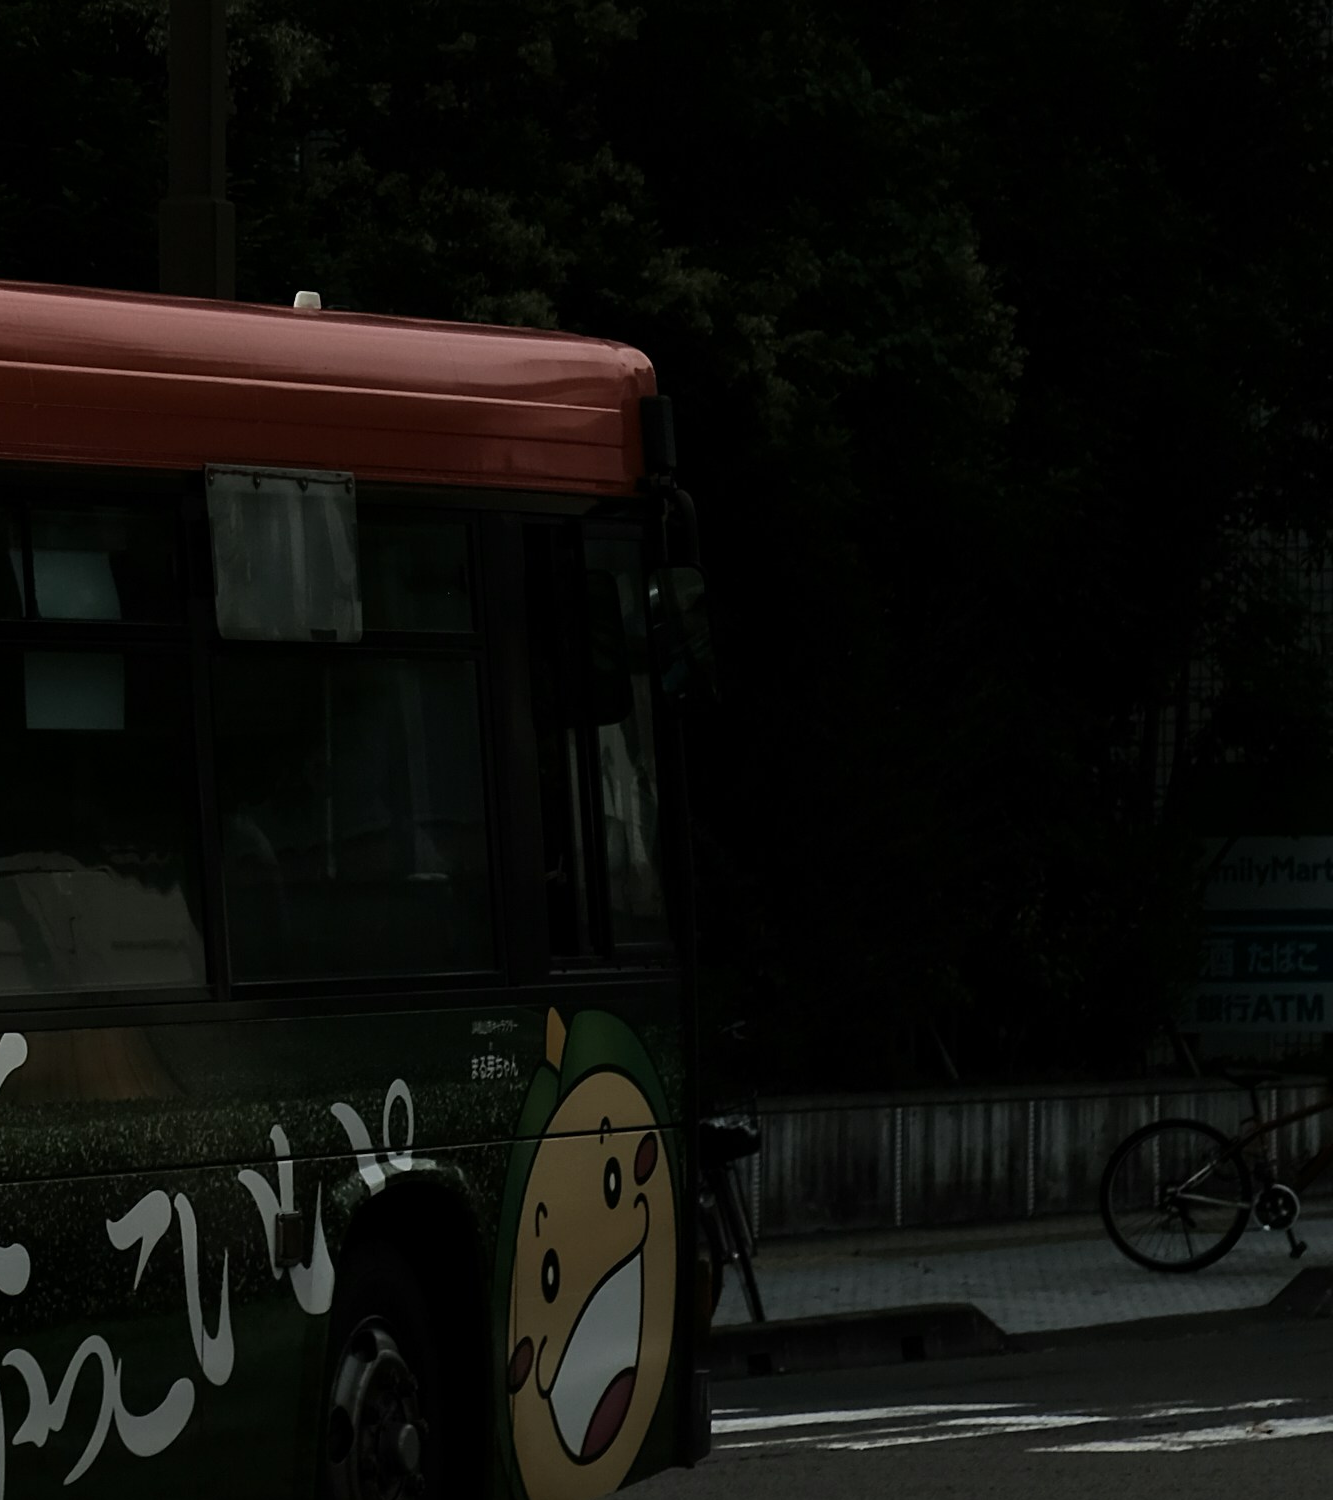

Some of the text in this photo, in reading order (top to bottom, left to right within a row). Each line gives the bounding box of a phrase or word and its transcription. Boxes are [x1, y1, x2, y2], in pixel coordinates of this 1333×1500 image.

[1247, 940, 1319, 975] たばこ
[1196, 994, 1324, 1023] 銀行ATM
